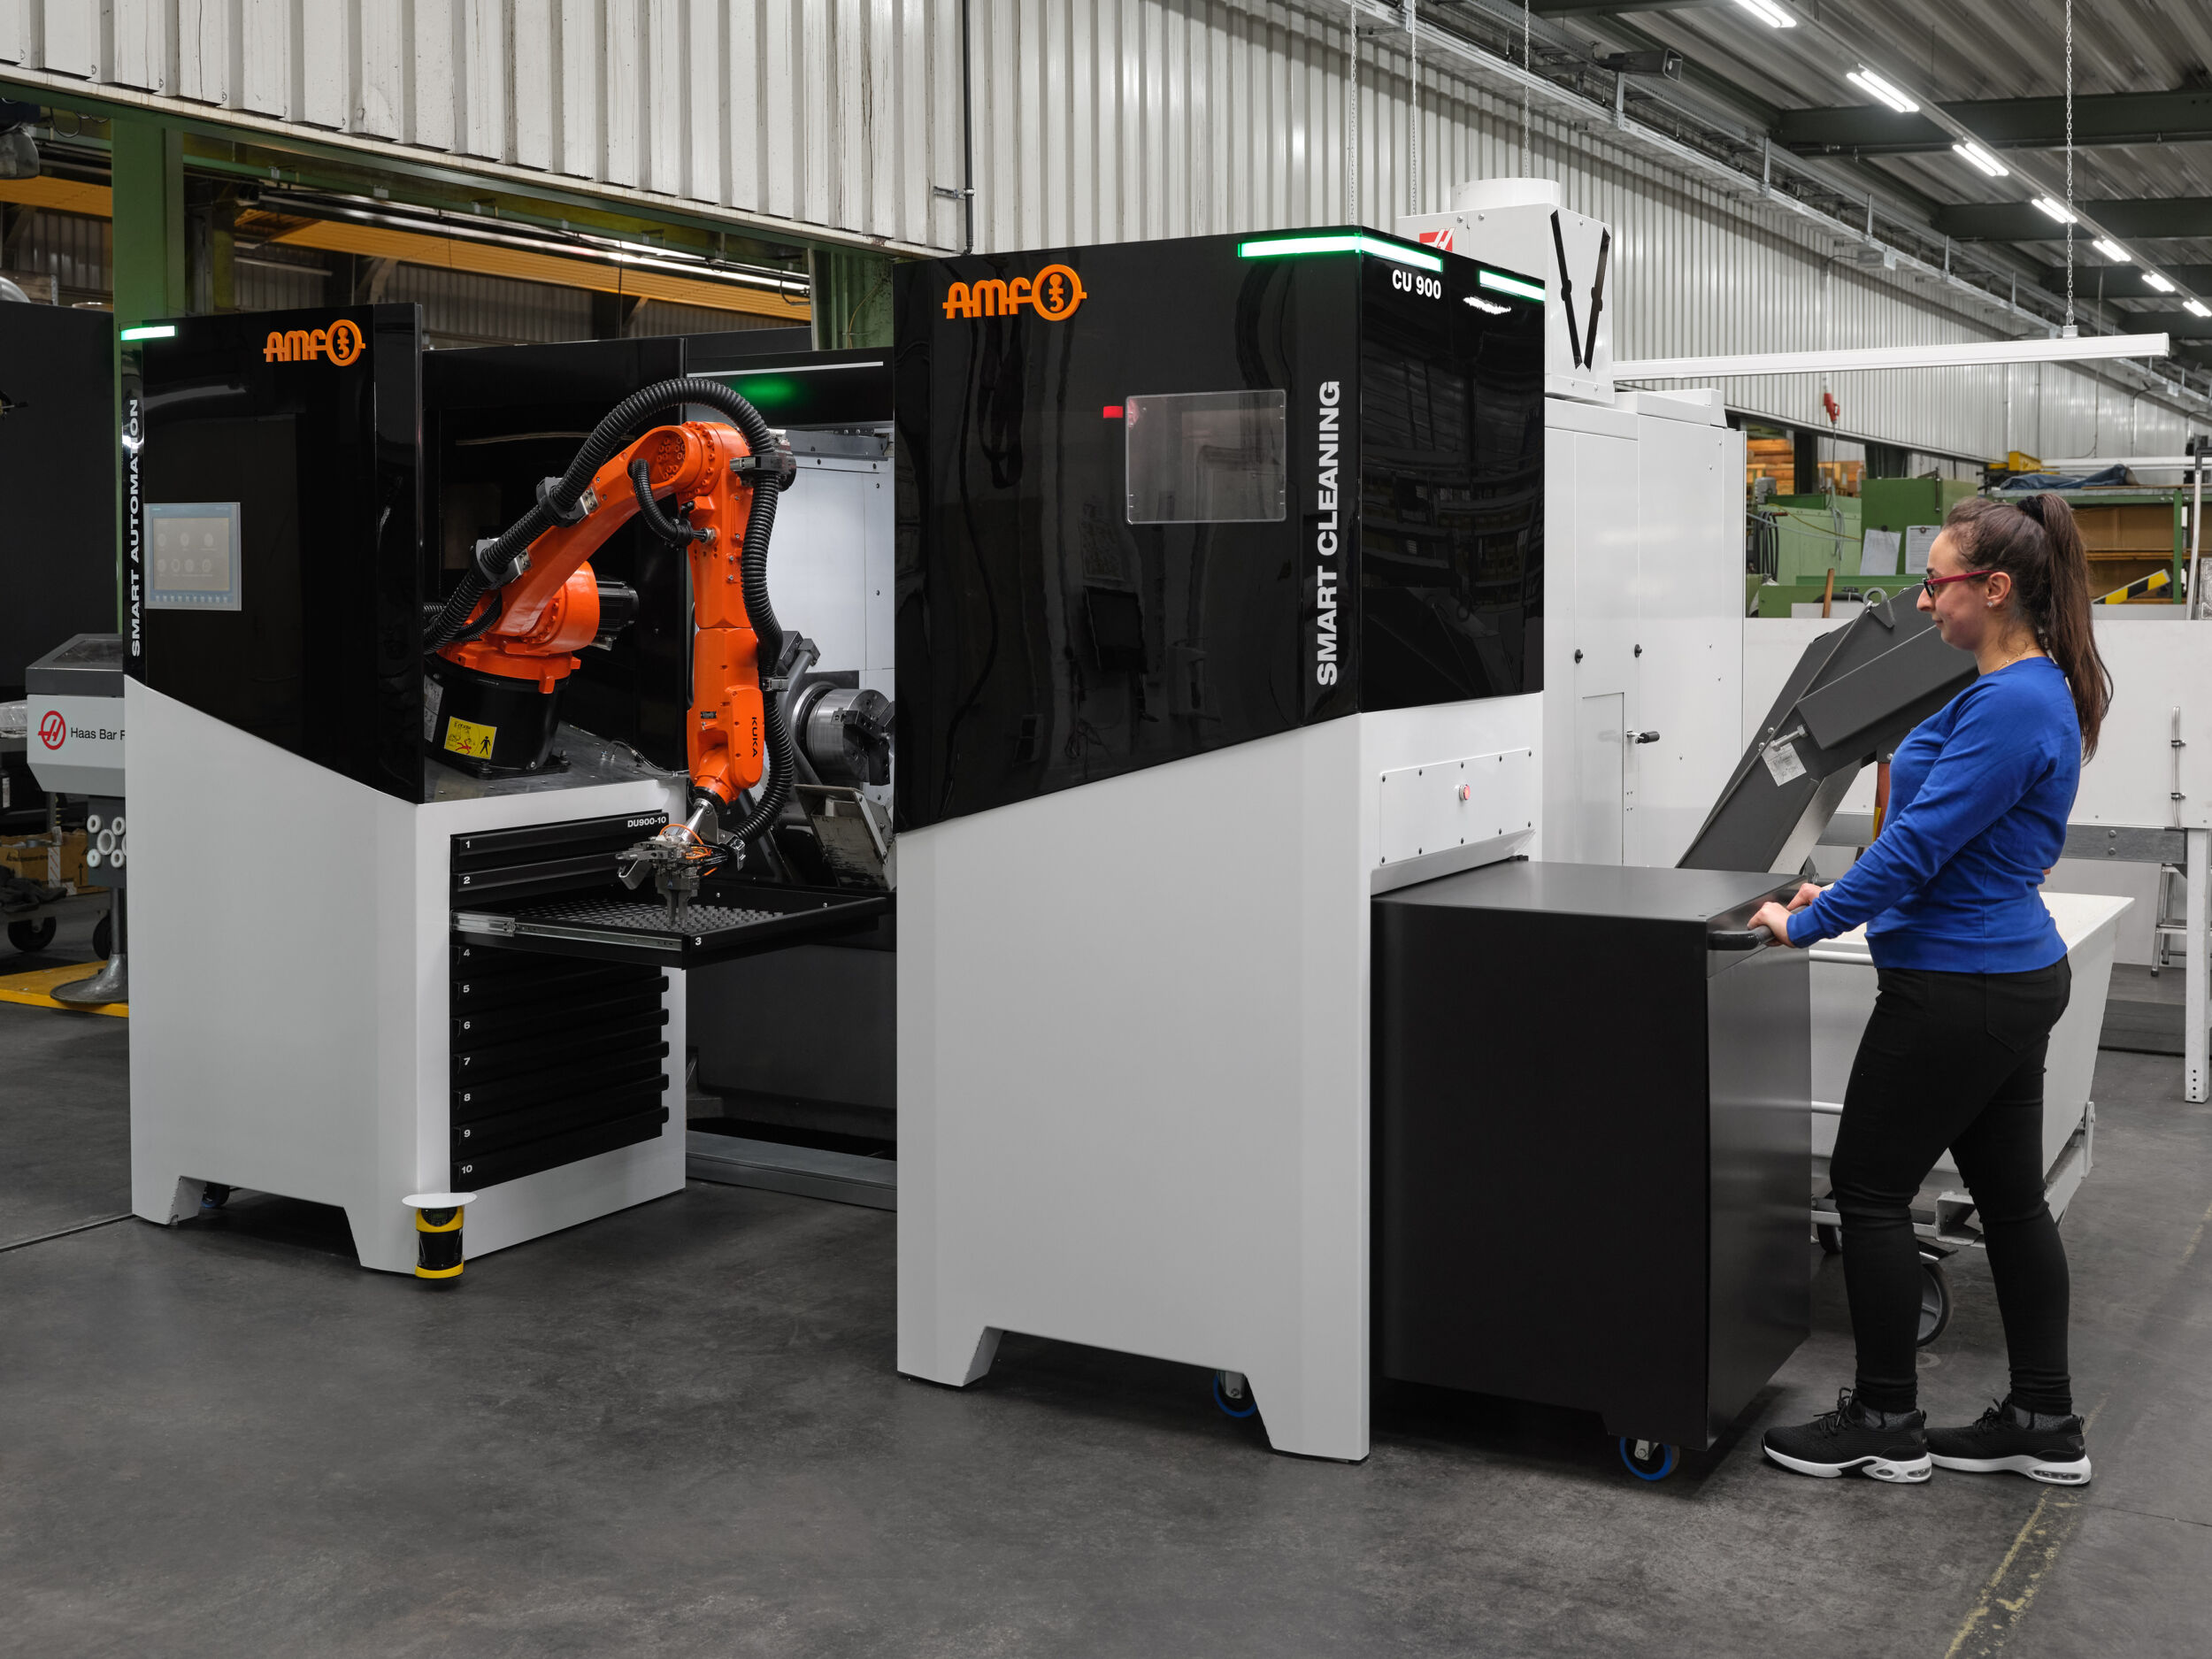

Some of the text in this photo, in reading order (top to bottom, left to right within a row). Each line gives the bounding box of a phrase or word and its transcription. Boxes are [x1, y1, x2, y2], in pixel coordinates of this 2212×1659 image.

[1392, 269, 1441, 300] CU 900
[129, 399, 141, 657] SMART AUTOMATION
[1317, 380, 1340, 686] SMART CLEANING
[70, 727, 96, 740] Haas
[99, 728, 117, 740] Bar
[627, 816, 666, 827] DU900-10
[463, 876, 471, 885] 2
[695, 936, 703, 946] 3
[463, 984, 471, 993] 5
[464, 1021, 471, 1030] 6
[464, 1057, 471, 1066] 7
[464, 1129, 471, 1138] 9
[461, 1164, 473, 1174] 10
